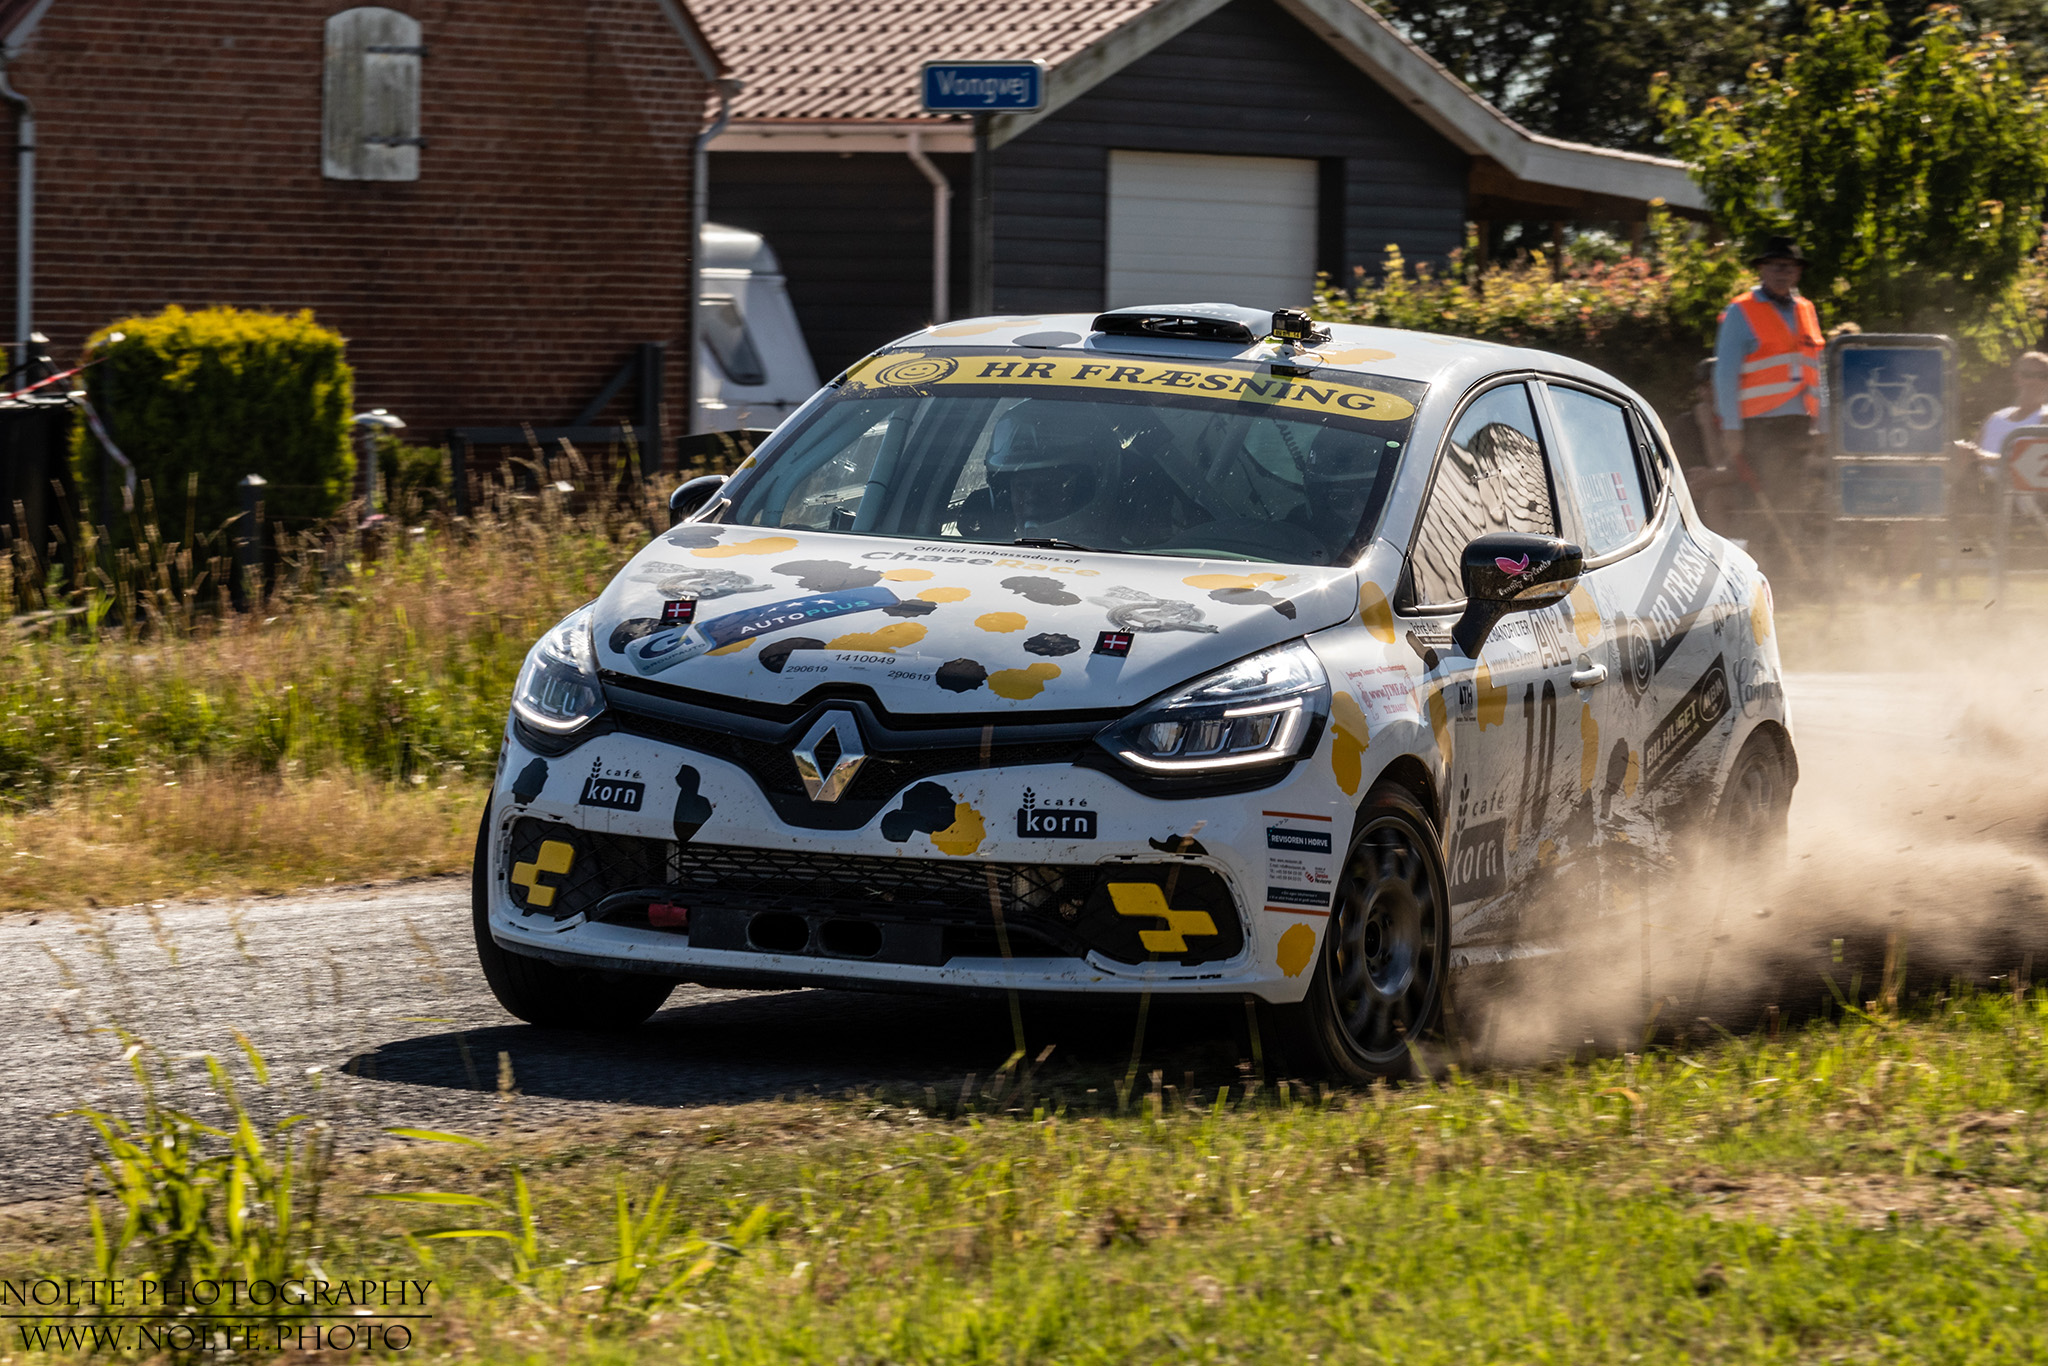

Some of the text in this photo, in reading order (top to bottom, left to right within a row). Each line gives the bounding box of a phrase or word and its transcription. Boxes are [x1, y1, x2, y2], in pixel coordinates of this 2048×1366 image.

[976, 361, 1376, 411] HR FRÆSNING
[914, 546, 966, 554] Official
[969, 549, 1060, 564] ambassadors
[740, 600, 870, 635] AUTOPLUS
[1649, 593, 1681, 647] HR
[786, 665, 828, 673] 290619
[835, 653, 896, 665] 1410049
[887, 670, 931, 681] 290619
[1646, 700, 1697, 769] BILHUSET
[1517, 679, 1557, 837] 10
[606, 768, 642, 779] café
[587, 779, 636, 804] korn
[1043, 798, 1088, 807] café
[1026, 814, 1088, 833] korn
[1450, 838, 1497, 887] korn
